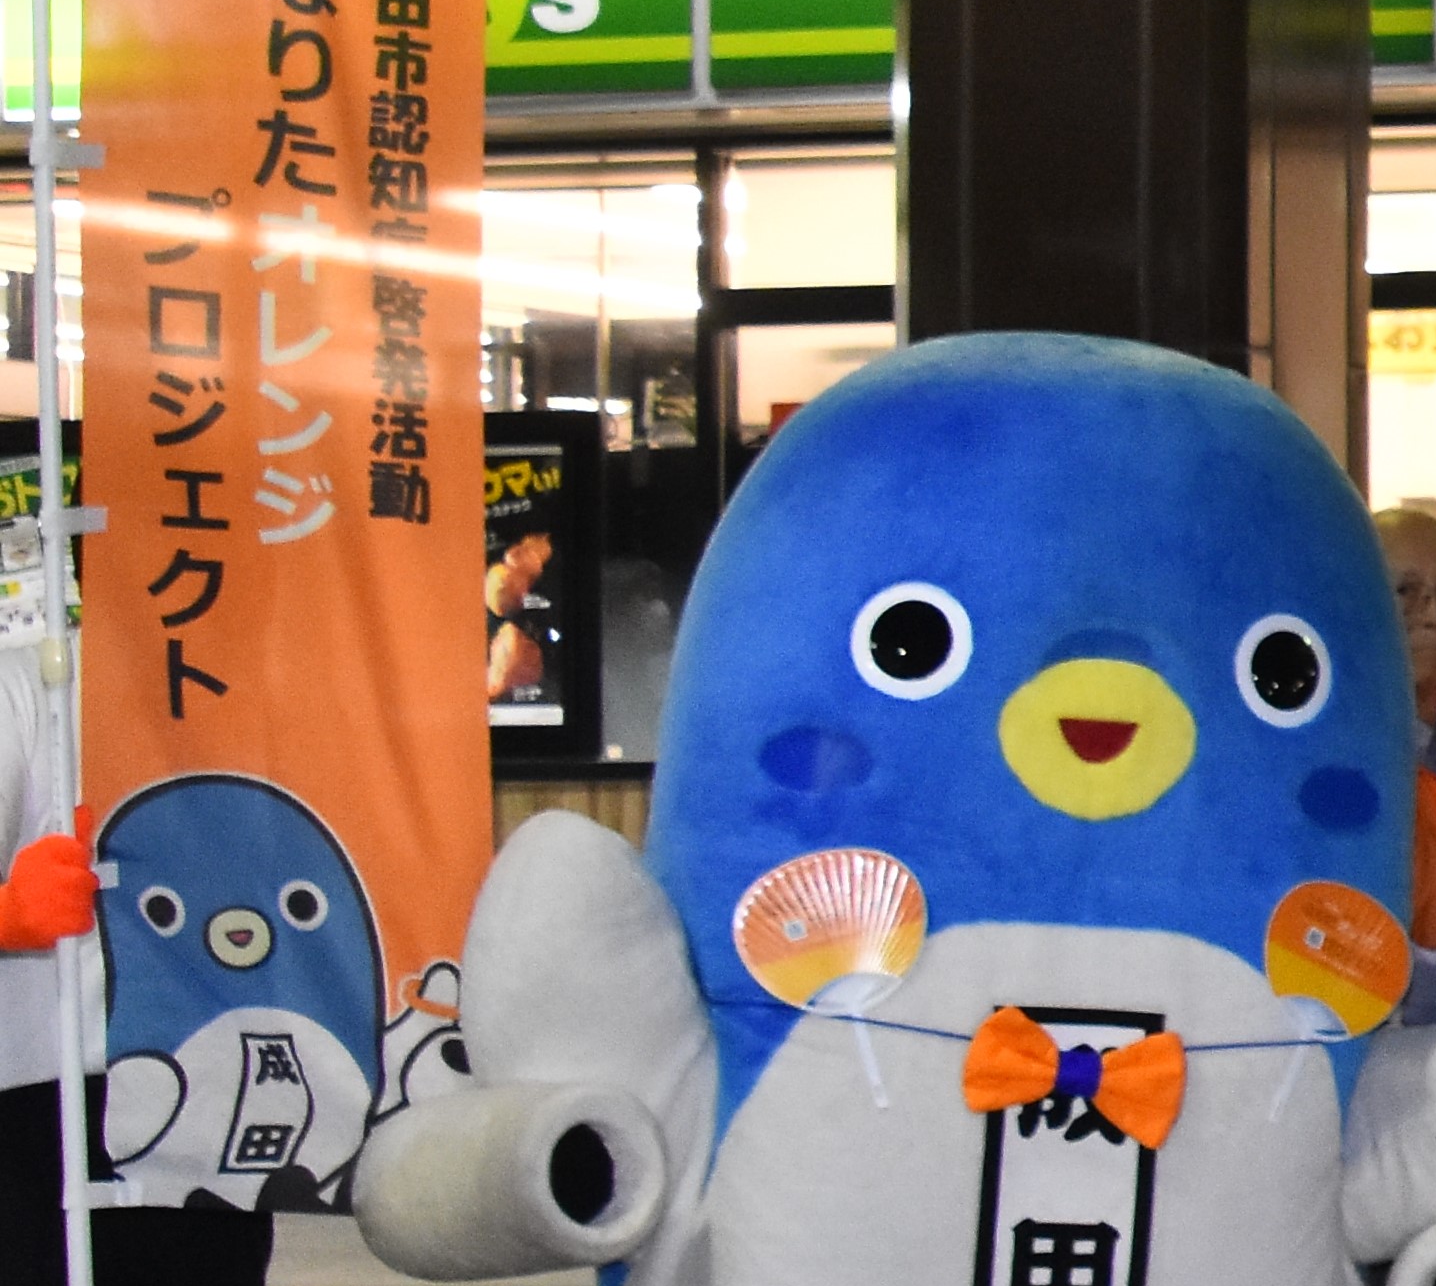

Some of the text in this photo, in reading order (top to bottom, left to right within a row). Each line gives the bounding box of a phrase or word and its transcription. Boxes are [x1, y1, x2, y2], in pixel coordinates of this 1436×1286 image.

[144, 187, 232, 719] プロジェクト
[236, 1041, 301, 1167] 成田
